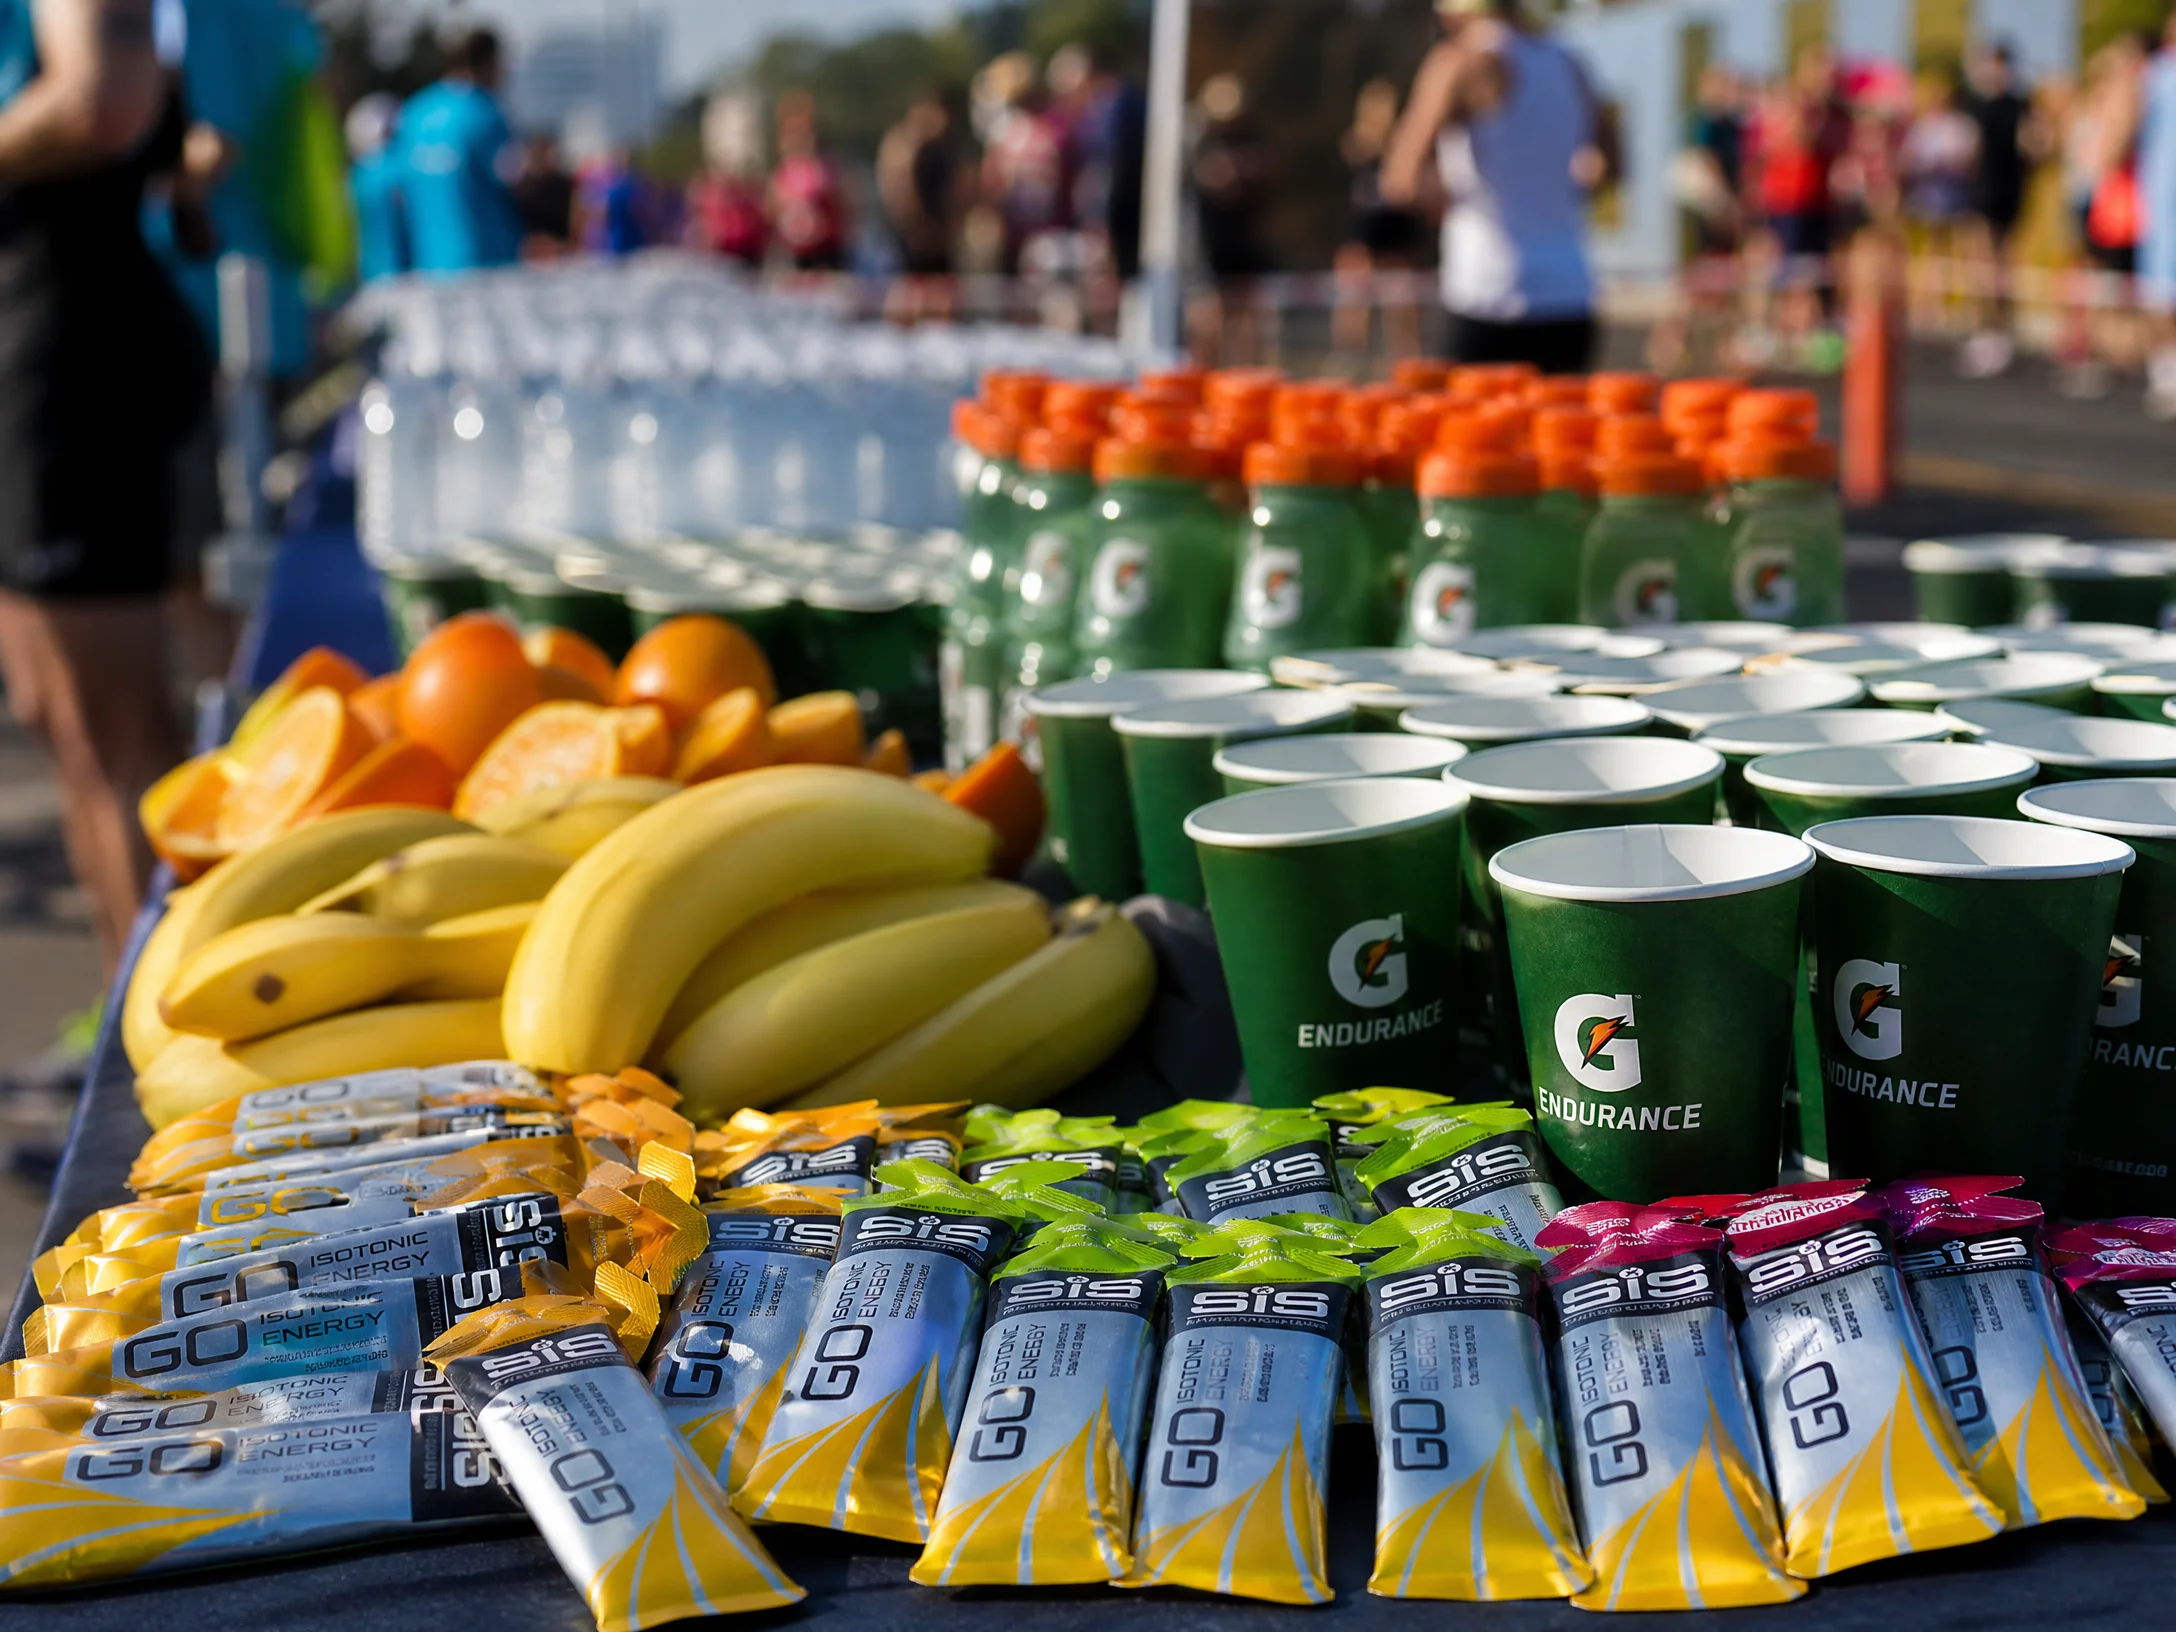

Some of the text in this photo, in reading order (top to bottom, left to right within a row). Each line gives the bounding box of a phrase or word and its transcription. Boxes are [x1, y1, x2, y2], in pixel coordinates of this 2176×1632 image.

[1328, 912, 1409, 1008] G
[1298, 999, 1443, 1048] ENDURANCE
[1834, 959, 1902, 1061] G
[1554, 994, 1641, 1092] G
[1539, 1086, 1702, 1131] ENDURANCE
[1205, 1152, 1326, 1200] SiS
[311, 1231, 429, 1268] ISOTONIC
[856, 1214, 992, 1252] SiS
[1749, 1230, 1883, 1293] SiS
[1007, 1275, 1142, 1303] SiS
[1189, 1284, 1330, 1315] SiS
[1380, 1262, 1521, 1312] SiS
[1562, 1263, 1710, 1315] SiS
[124, 1318, 248, 1379] GO
[262, 1310, 387, 1347] ENERGY
[481, 1332, 618, 1380] SiS
[664, 1320, 735, 1399] GO
[800, 1324, 873, 1401] GO
[1932, 1345, 1988, 1427] GO
[93, 1400, 217, 1437] GO
[969, 1385, 1036, 1463] GO
[1392, 1397, 1449, 1473] GO
[1782, 1360, 1852, 1450] GO
[77, 1440, 223, 1481] GO
[1161, 1406, 1226, 1489] GO
[1585, 1399, 1649, 1487] GO
[549, 1447, 635, 1526] GO
